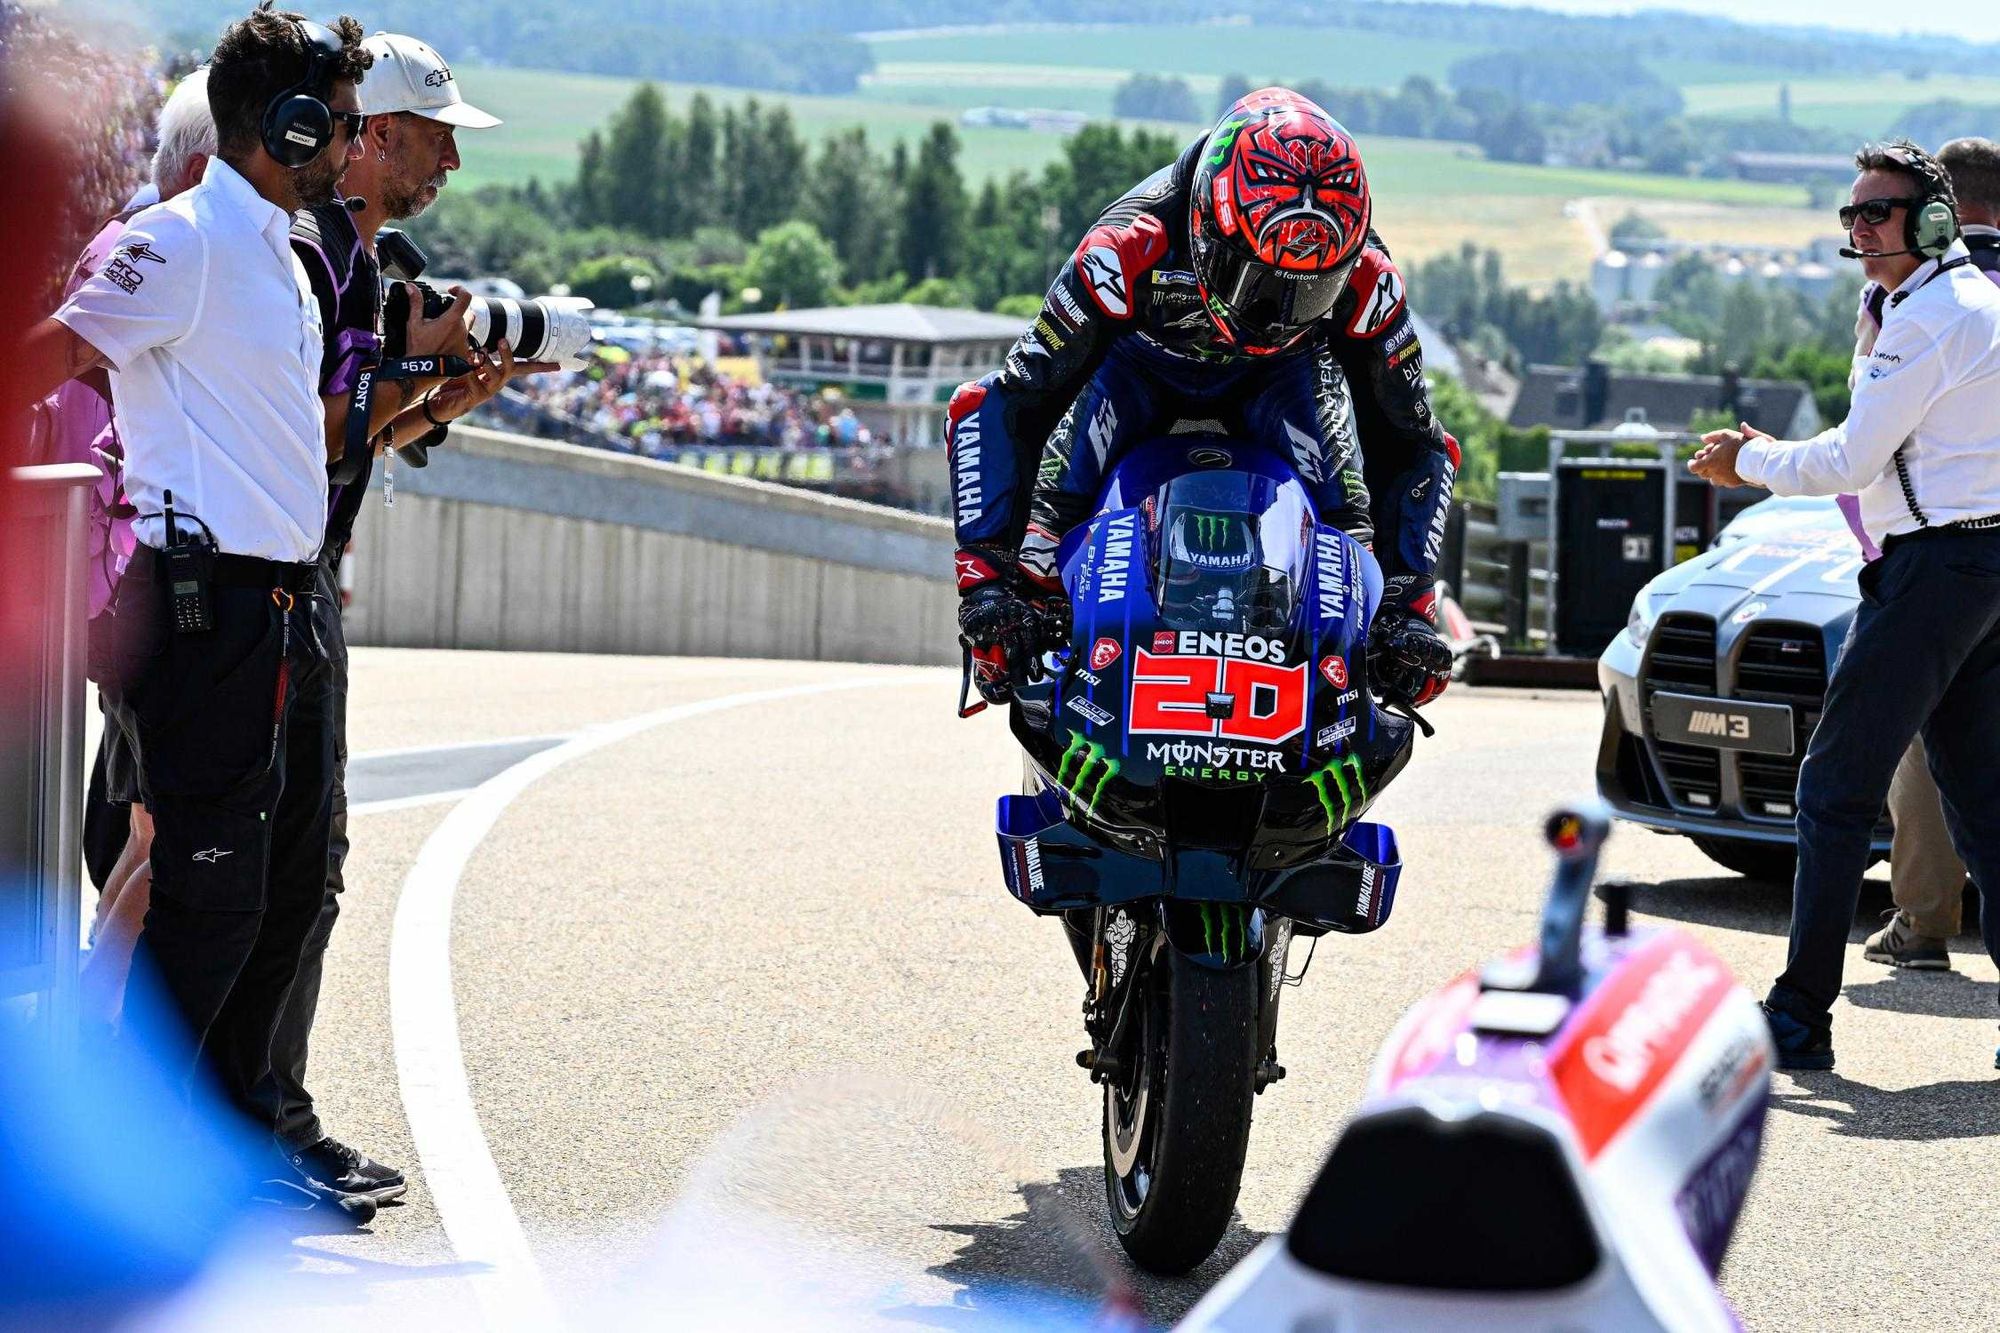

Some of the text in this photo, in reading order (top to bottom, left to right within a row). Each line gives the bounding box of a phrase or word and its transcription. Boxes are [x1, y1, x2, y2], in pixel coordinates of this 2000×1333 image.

[106, 266, 138, 292] MOTOR
[110, 258, 144, 285] PRO
[1054, 281, 1090, 327] YAMALUBE
[355, 372, 372, 412] SONY
[957, 411, 982, 528] YAMAHA
[1423, 459, 1455, 564] YAMAHA
[1098, 513, 1135, 604] YAMAHA
[1190, 551, 1252, 567] YAMAHA
[1316, 533, 1345, 620] YAMAHA
[1178, 630, 1286, 664] ENEOS
[1075, 668, 1102, 686] msi
[1336, 689, 1359, 706] msi
[1146, 740, 1287, 773] MONSTER
[1165, 765, 1266, 783] ENERGY
[1024, 836, 1045, 892] YAMALUBE
[1355, 861, 1376, 918] YAMALUBE
